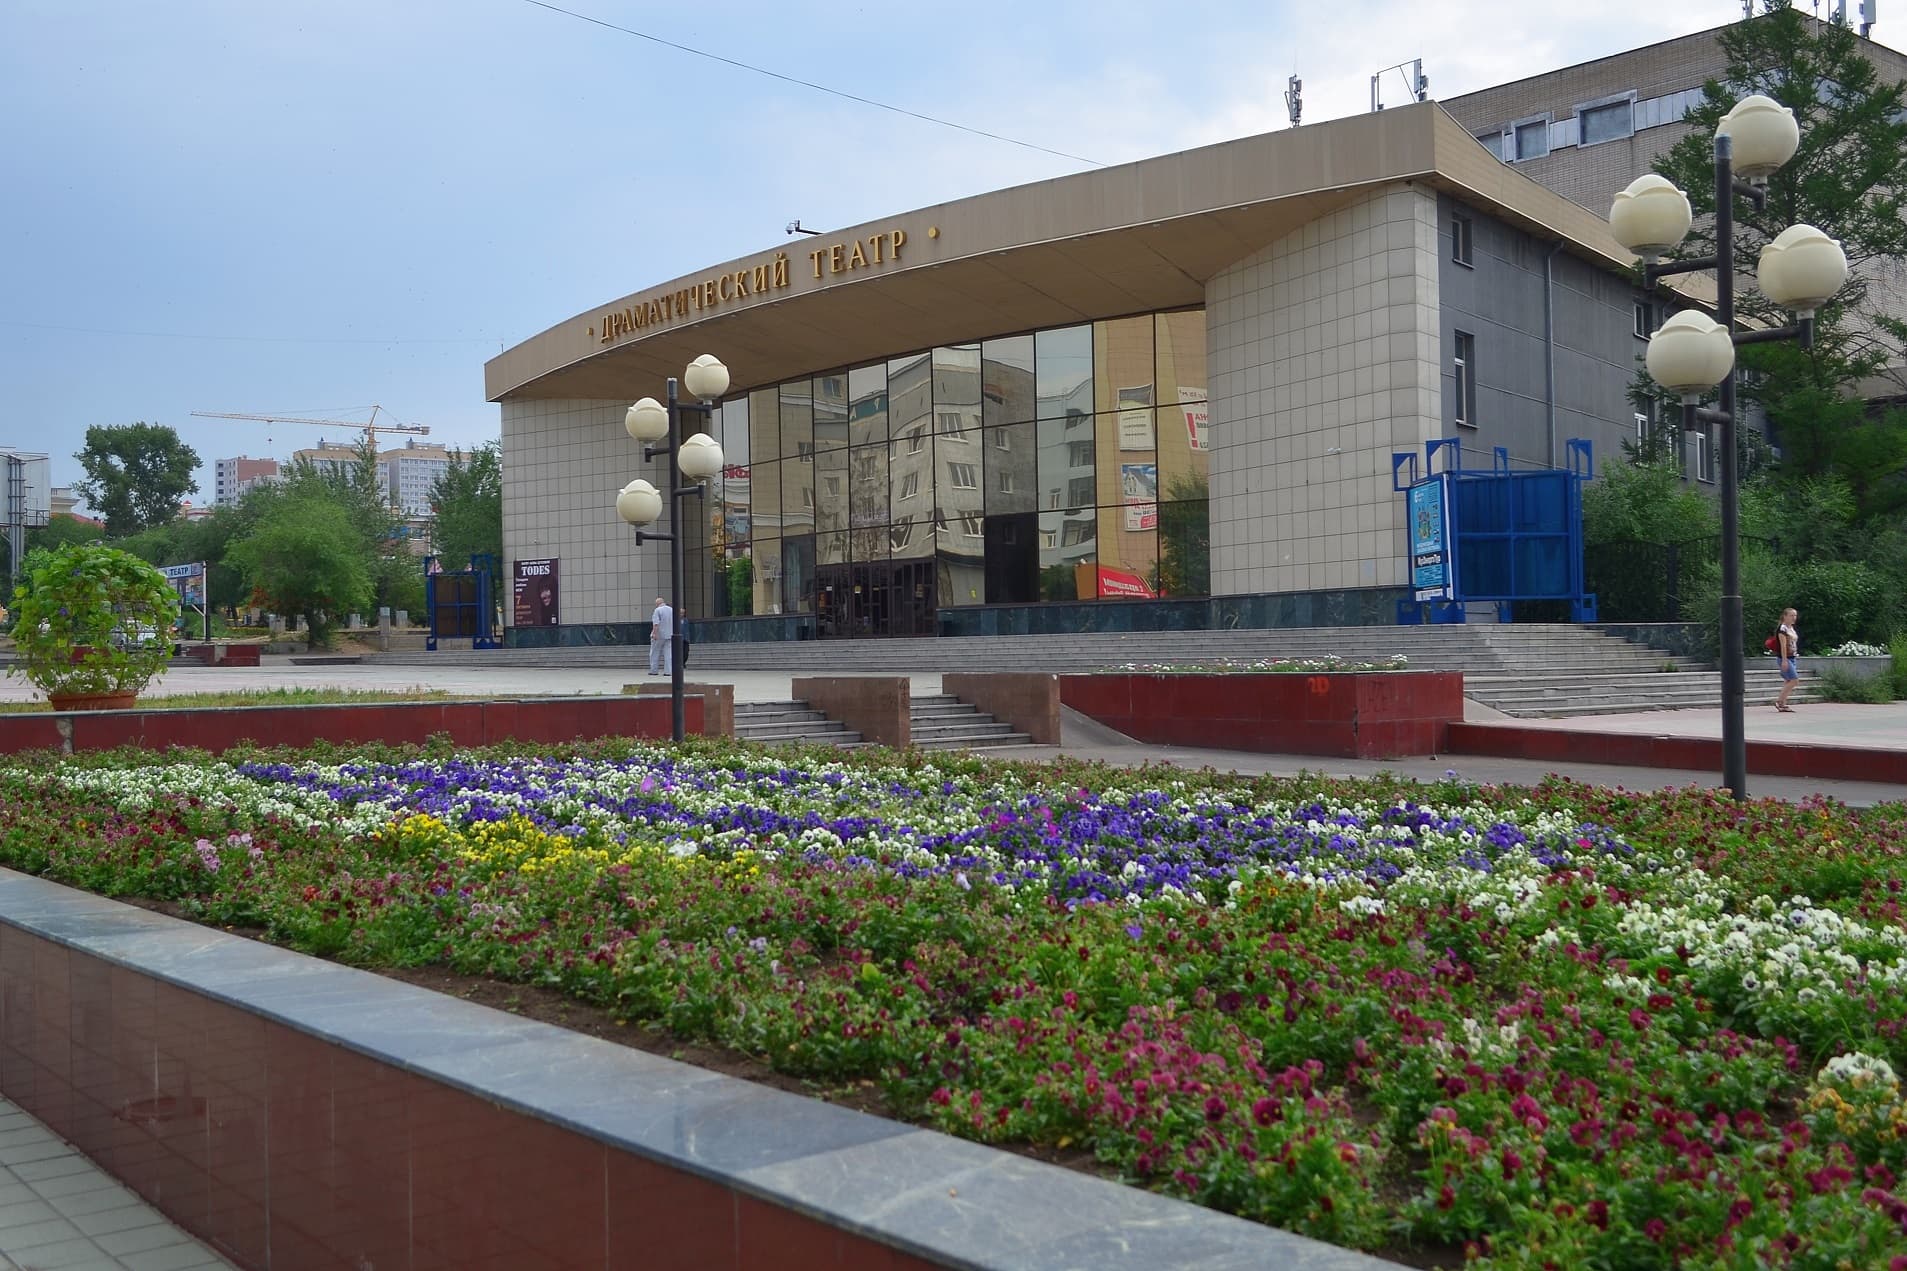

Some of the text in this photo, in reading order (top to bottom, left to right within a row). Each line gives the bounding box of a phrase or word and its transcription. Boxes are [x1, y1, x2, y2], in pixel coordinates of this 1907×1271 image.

[601, 229, 907, 343] ДРАМАТИЧЕСКИЙ ТЕАТР
[170, 567, 189, 577] ТЕАТР
[521, 565, 551, 576] TODES
